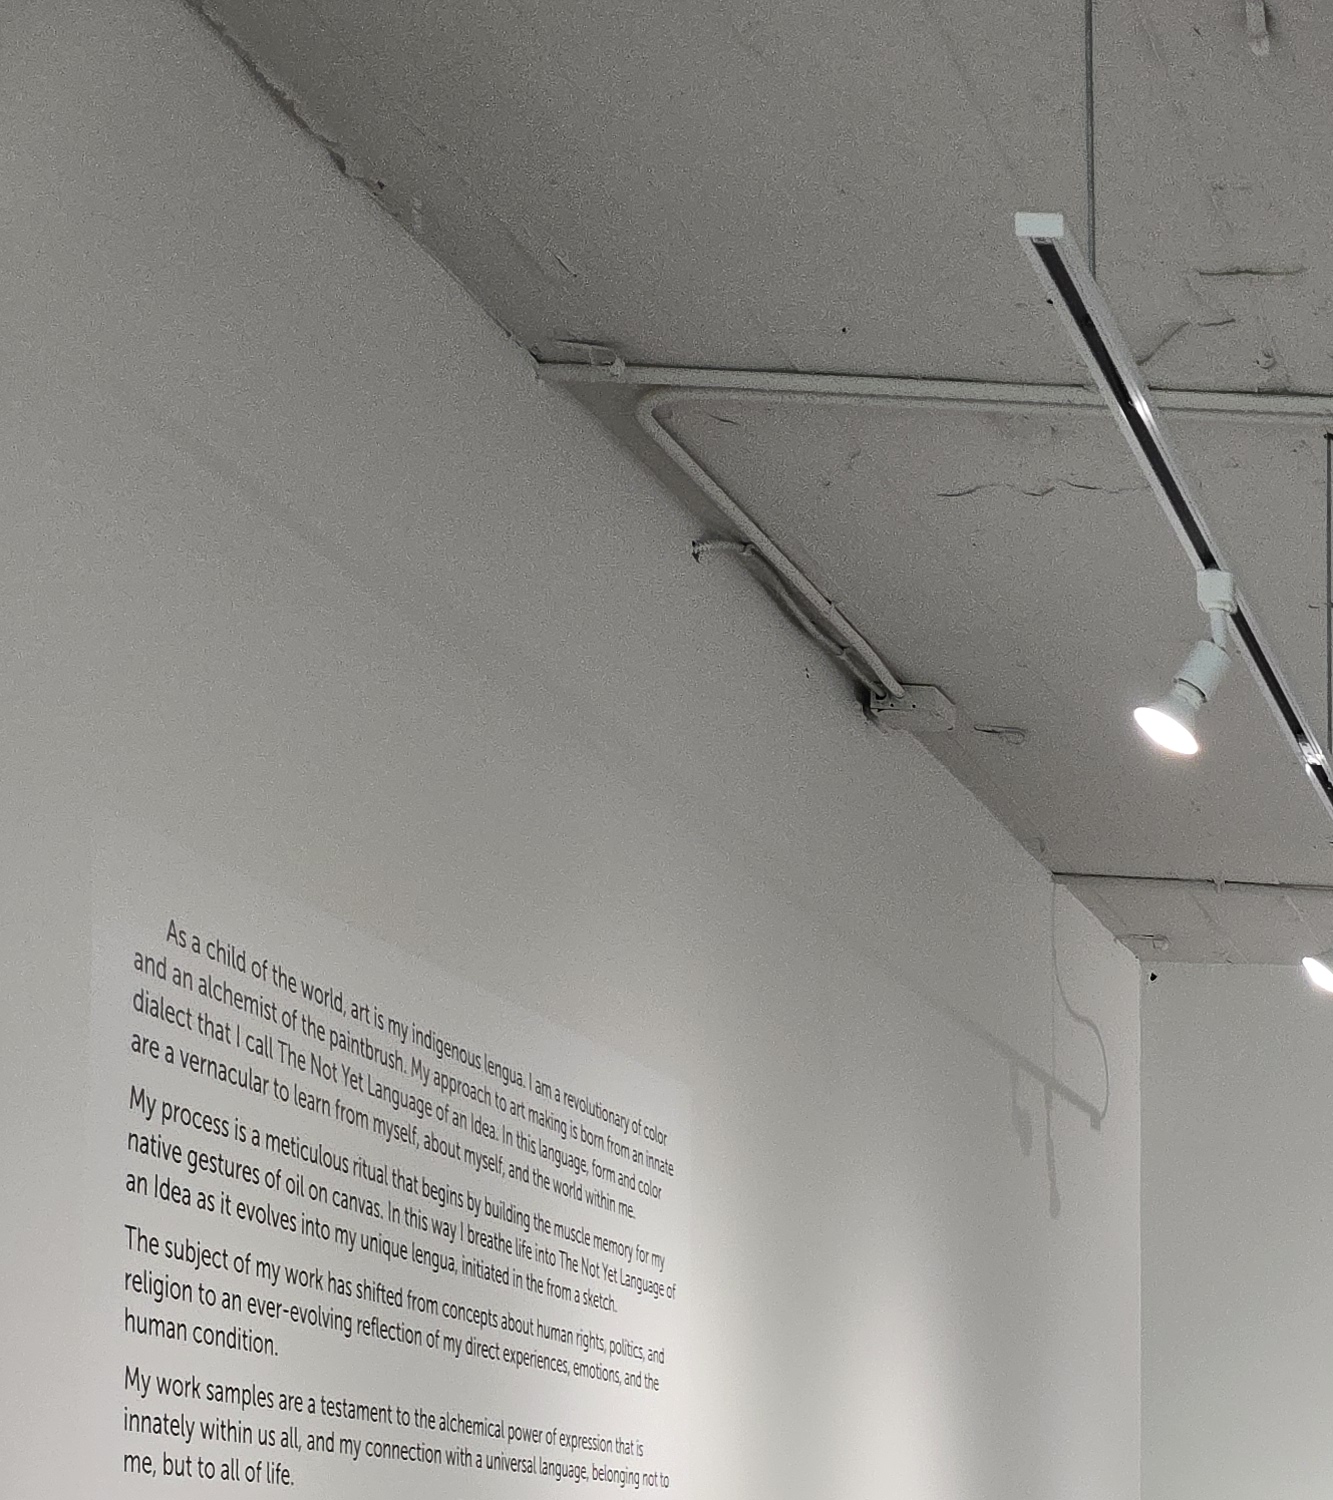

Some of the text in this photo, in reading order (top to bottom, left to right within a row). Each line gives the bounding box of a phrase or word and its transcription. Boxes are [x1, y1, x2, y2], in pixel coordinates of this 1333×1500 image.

[166, 919, 187, 949] As
[191, 935, 201, 955] a
[206, 938, 246, 974] child
[251, 959, 268, 982] of
[272, 964, 297, 994] the
[300, 980, 347, 1018] world,
[350, 1002, 371, 1025] art
[374, 1005, 384, 1031] is
[388, 1017, 409, 1045] my
[412, 1021, 482, 1070] indigenous
[484, 1052, 526, 1089] lengua.
[534, 1079, 552, 1100] am
[554, 1088, 561, 1103] a
[563, 1091, 630, 1135] revolutionary
[631, 1118, 642, 1136] of
[643, 1125, 668, 1147] color
[129, 1084, 665, 1273] My process is a meticulous ritual that begins by building the muscle memory for my
[124, 1224, 665, 1365] The subject of my work has shifted from concepts about human rights, politics, and
[124, 1306, 278, 1357] human condition.
[124, 1451, 294, 1486] me, but to all of life.
